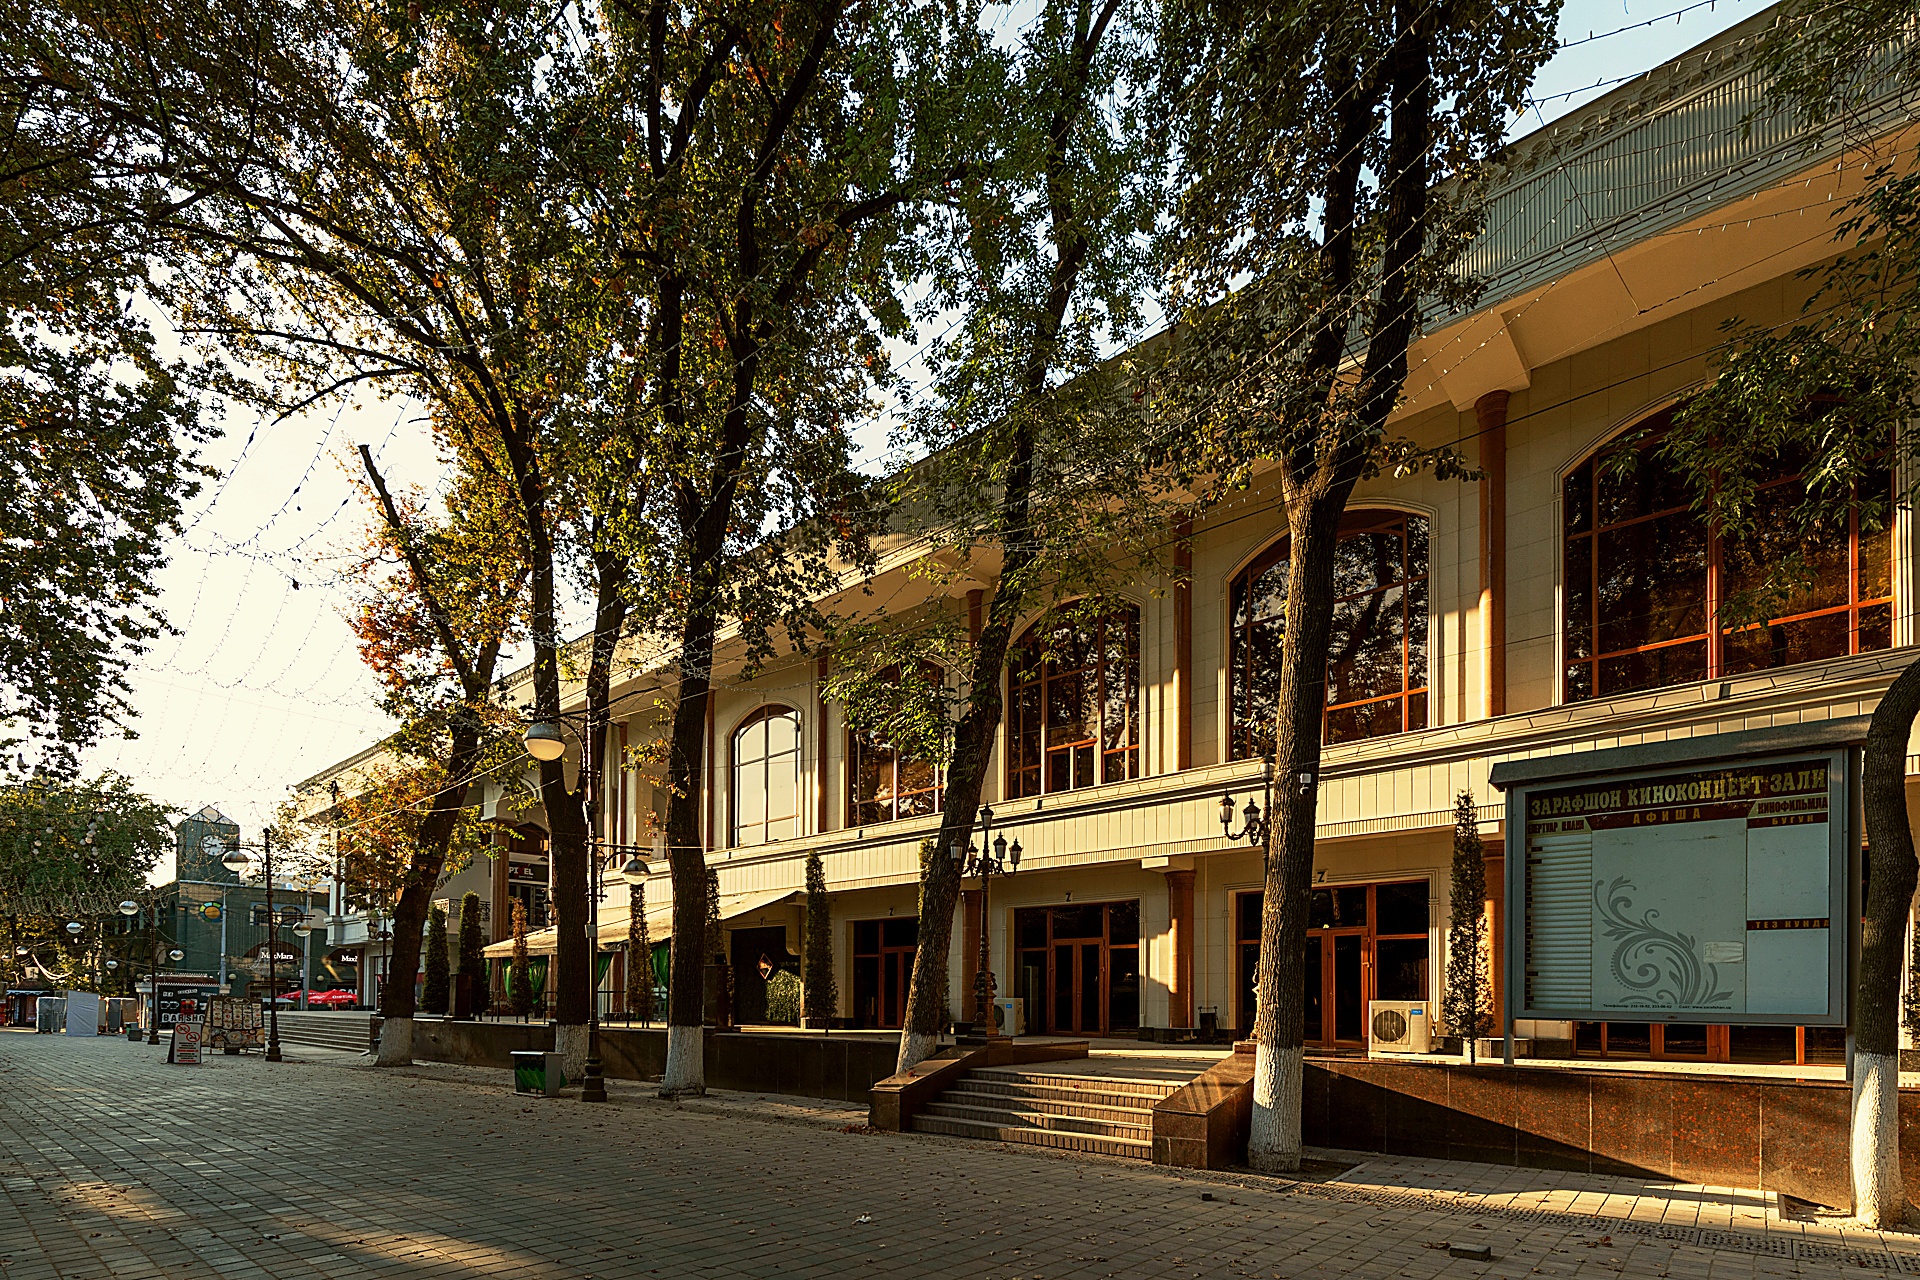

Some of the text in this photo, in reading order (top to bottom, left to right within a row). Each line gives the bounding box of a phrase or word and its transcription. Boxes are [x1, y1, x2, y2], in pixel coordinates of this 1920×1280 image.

[1531, 768, 1826, 816] ЗАРАФШОН КИНОКОНЦЕРТ ЗАЛИ
[1633, 808, 1701, 825] АФИША
[1756, 921, 1778, 929] ТЕЗ
